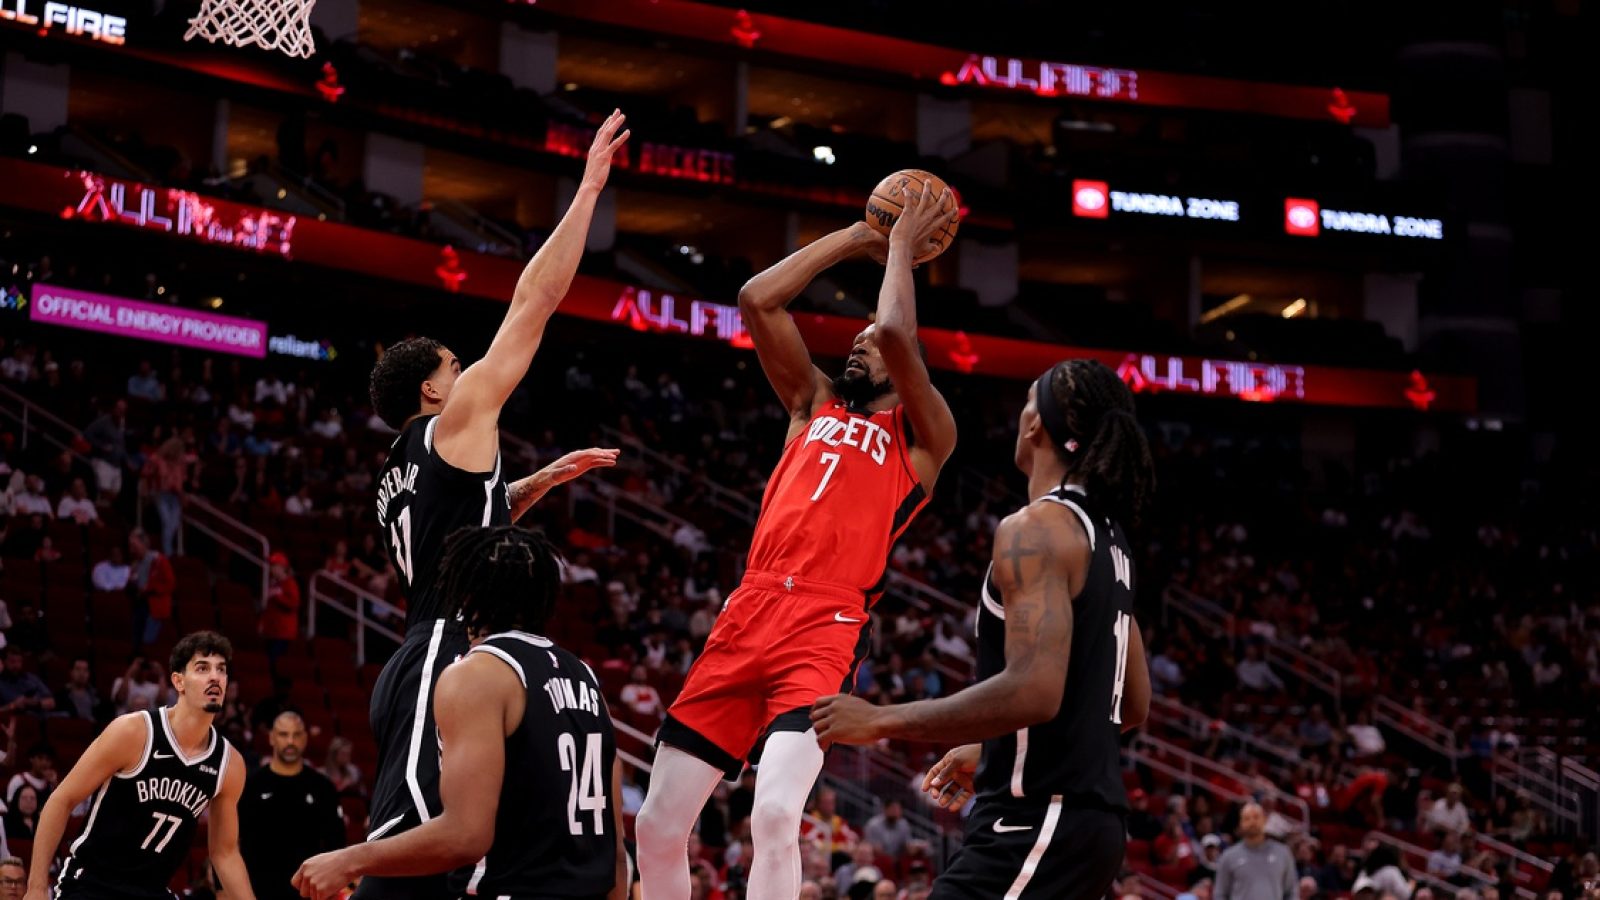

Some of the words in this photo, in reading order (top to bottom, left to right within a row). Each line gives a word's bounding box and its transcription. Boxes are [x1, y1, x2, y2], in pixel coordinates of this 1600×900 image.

[44, 1, 126, 45] FIRE
[1110, 191, 1184, 216] TUNDRA
[1186, 198, 1240, 221] ZONE
[1320, 209, 1391, 235] TUNDRA
[1393, 216, 1443, 240] ZONE
[37, 294, 115, 325] OFFICIAL
[116, 306, 181, 335] ENERGY
[182, 318, 261, 349] PROVIDER
[268, 334, 320, 360] reliant
[803, 416, 891, 466] OCETS
[810, 451, 841, 502] 7
[543, 677, 599, 717] TOMAS
[137, 777, 209, 818] BROOKLYN
[558, 732, 607, 835] 24
[140, 811, 182, 853] 77
